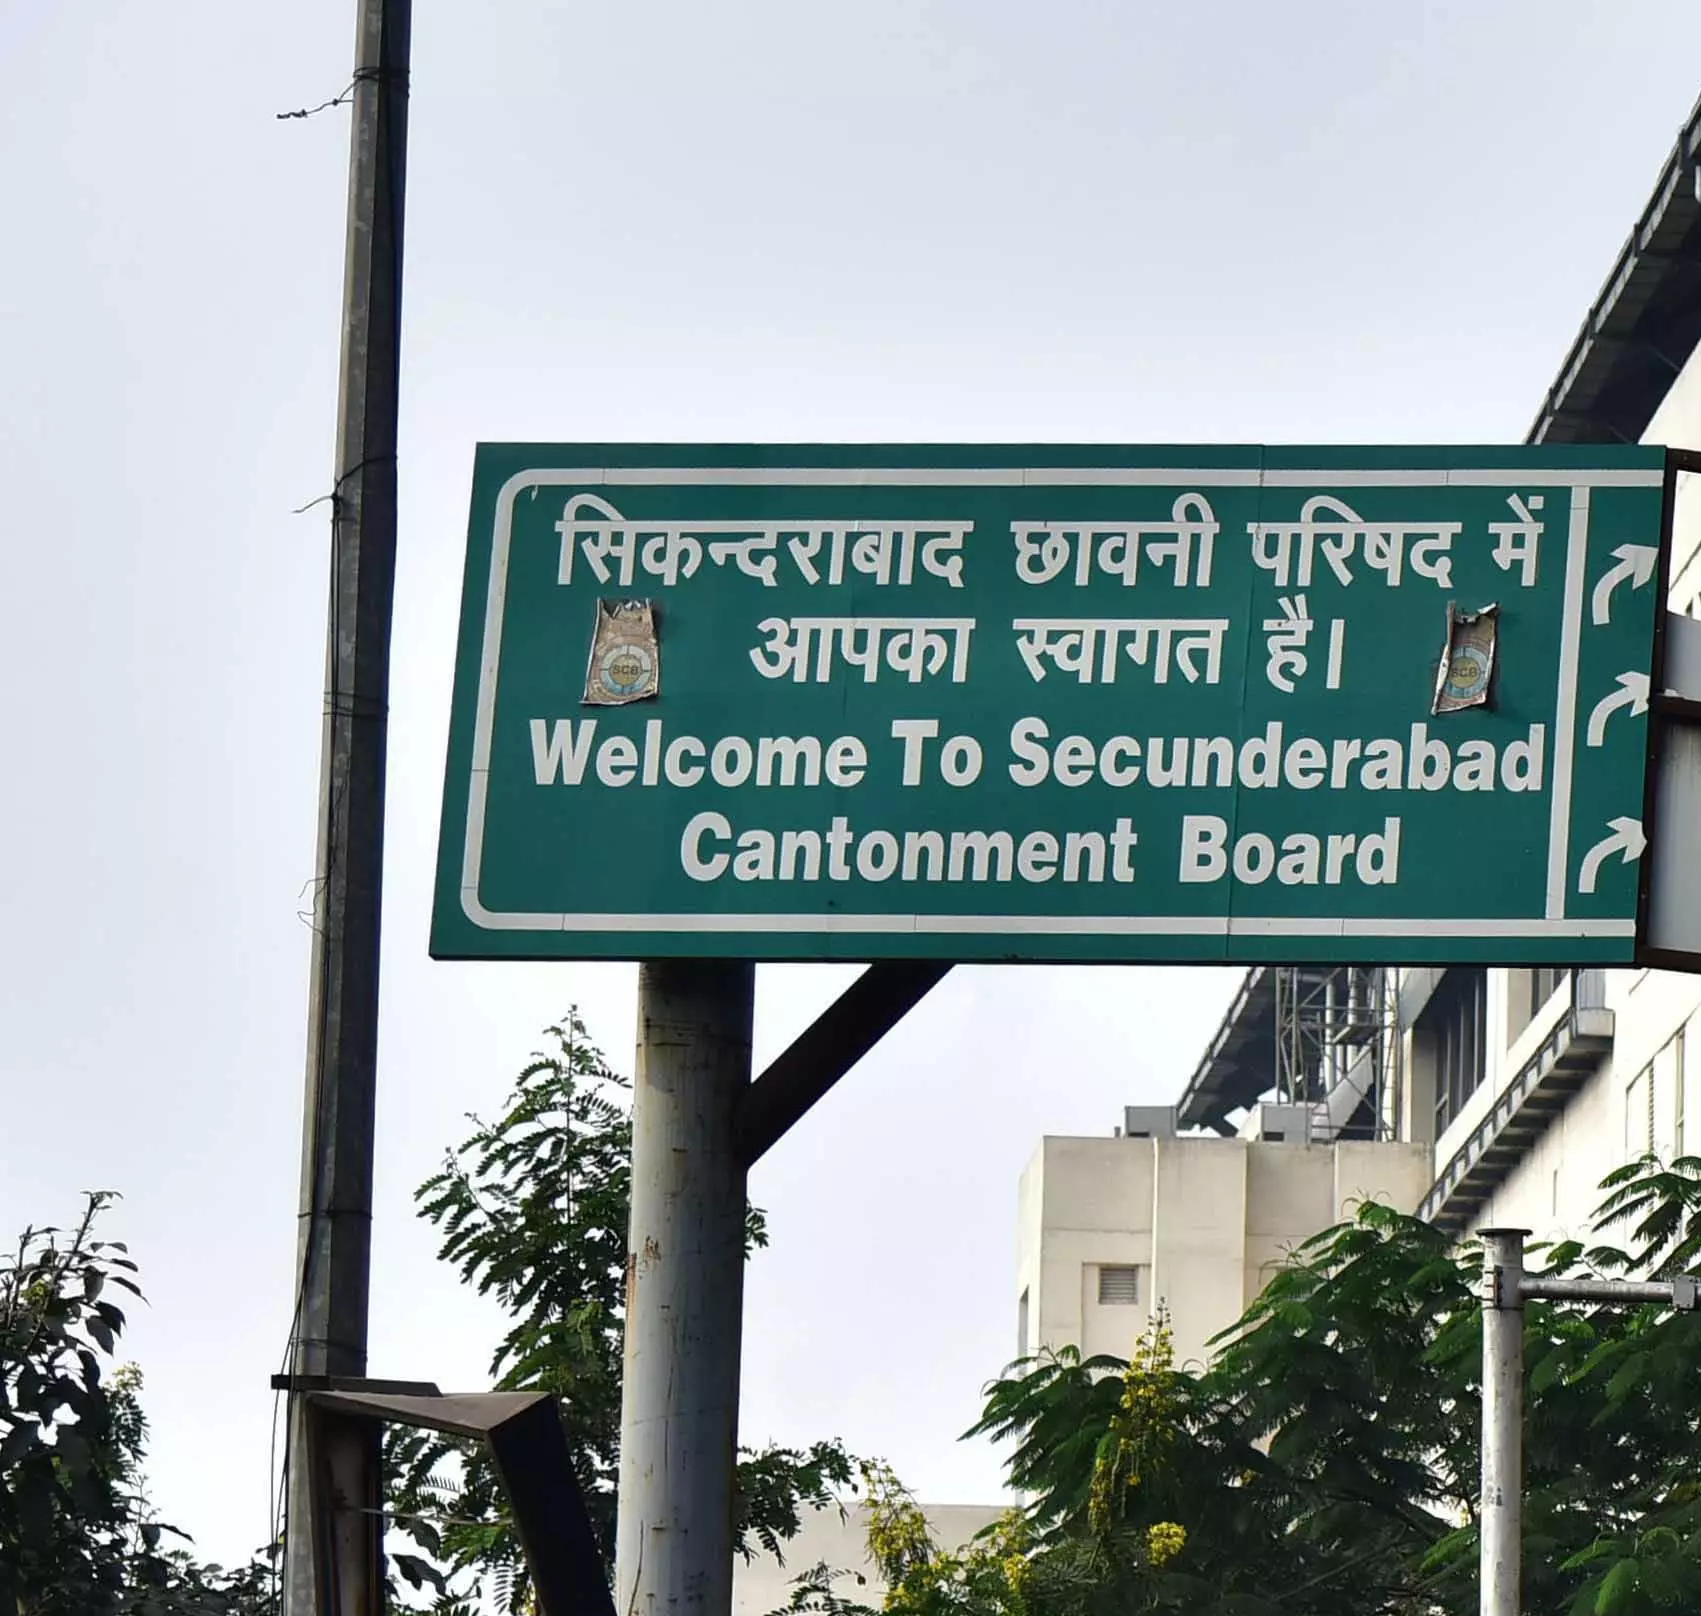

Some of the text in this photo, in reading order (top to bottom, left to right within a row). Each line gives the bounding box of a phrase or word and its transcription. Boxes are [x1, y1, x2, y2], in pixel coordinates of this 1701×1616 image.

[555, 492, 1545, 589] सिकन्दराबाद छावनी परिषद में
[749, 617, 976, 683] आपका
[1013, 618, 1229, 684] स्वागत
[530, 716, 1545, 793] Welcome To Secunderabad
[681, 811, 1401, 885] Cantonment Board
